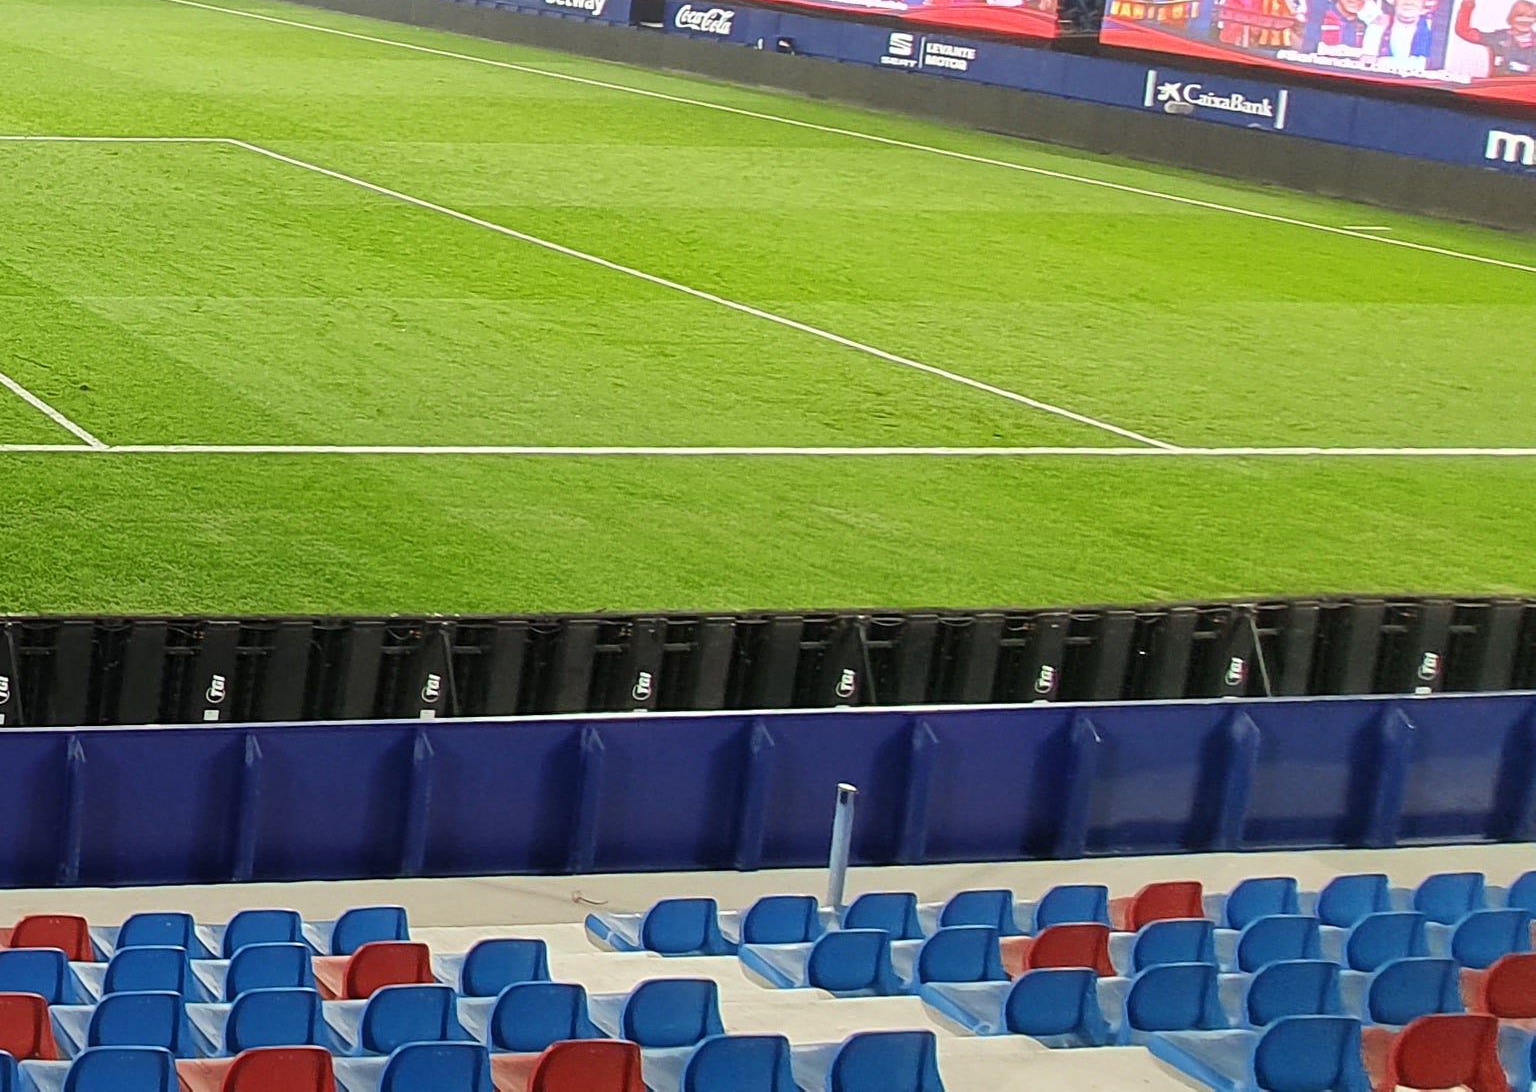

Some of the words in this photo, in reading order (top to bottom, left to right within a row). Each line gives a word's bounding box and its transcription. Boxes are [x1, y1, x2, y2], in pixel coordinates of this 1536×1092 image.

[1183, 84, 1273, 117] CaixaBank
[209, 674, 225, 698] TGI
[424, 674, 441, 698] TGI
[635, 672, 652, 696] TGI
